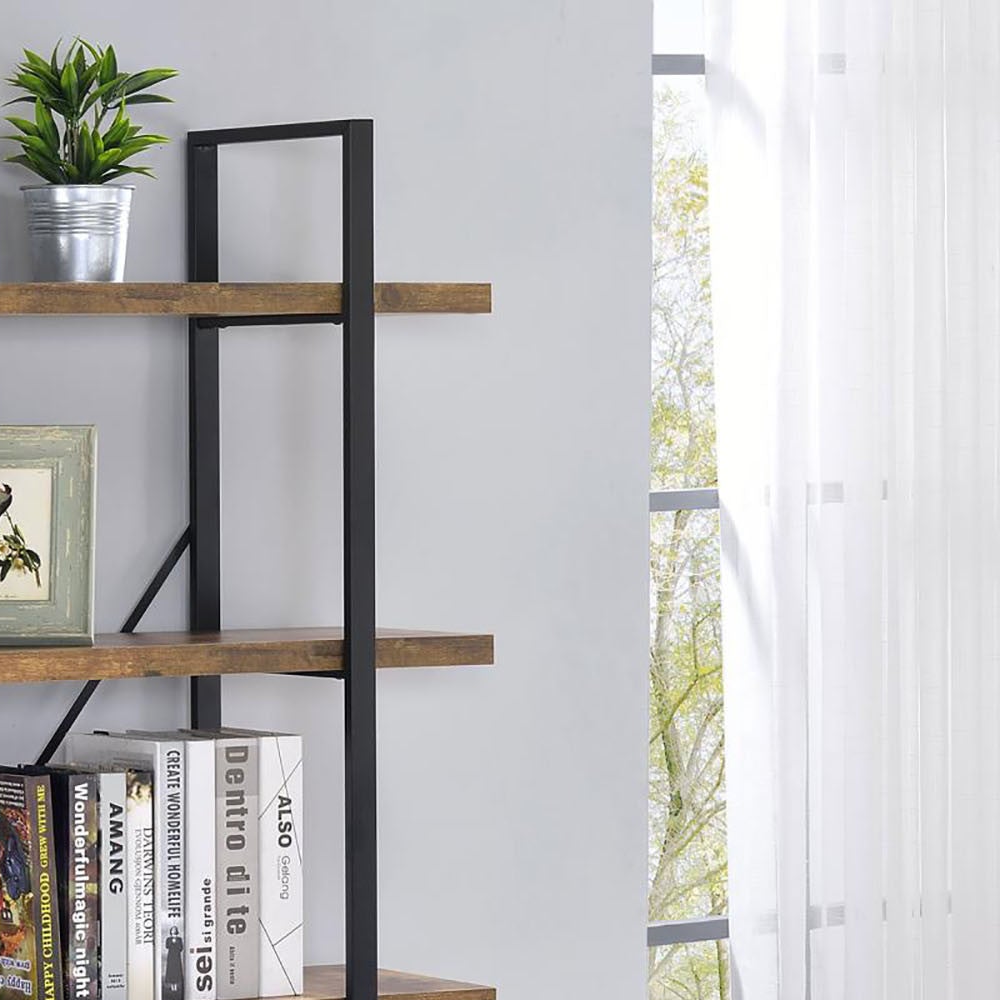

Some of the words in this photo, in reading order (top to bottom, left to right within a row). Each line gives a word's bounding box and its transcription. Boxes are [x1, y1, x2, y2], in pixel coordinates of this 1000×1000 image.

[166, 750, 181, 789] CREATE
[36, 785, 46, 803] ME
[225, 746, 249, 850] Dentro
[166, 794, 181, 861] WONDERFUL
[278, 795, 292, 848] ALSO
[38, 838, 48, 868] GREW
[109, 802, 124, 895] AMANG
[143, 827, 154, 896] DARWINS
[166, 864, 181, 919] HOMELIFE
[226, 866, 250, 896] di
[280, 855, 291, 900] Gelang
[40, 872, 52, 958] CHILDHOOD
[143, 900, 154, 945] TEORI
[202, 878, 214, 928] grande
[226, 905, 249, 935] te
[202, 931, 213, 944] si
[6, 976, 32, 994] Happy
[73, 947, 89, 998] night
[189, 948, 213, 992] sei
